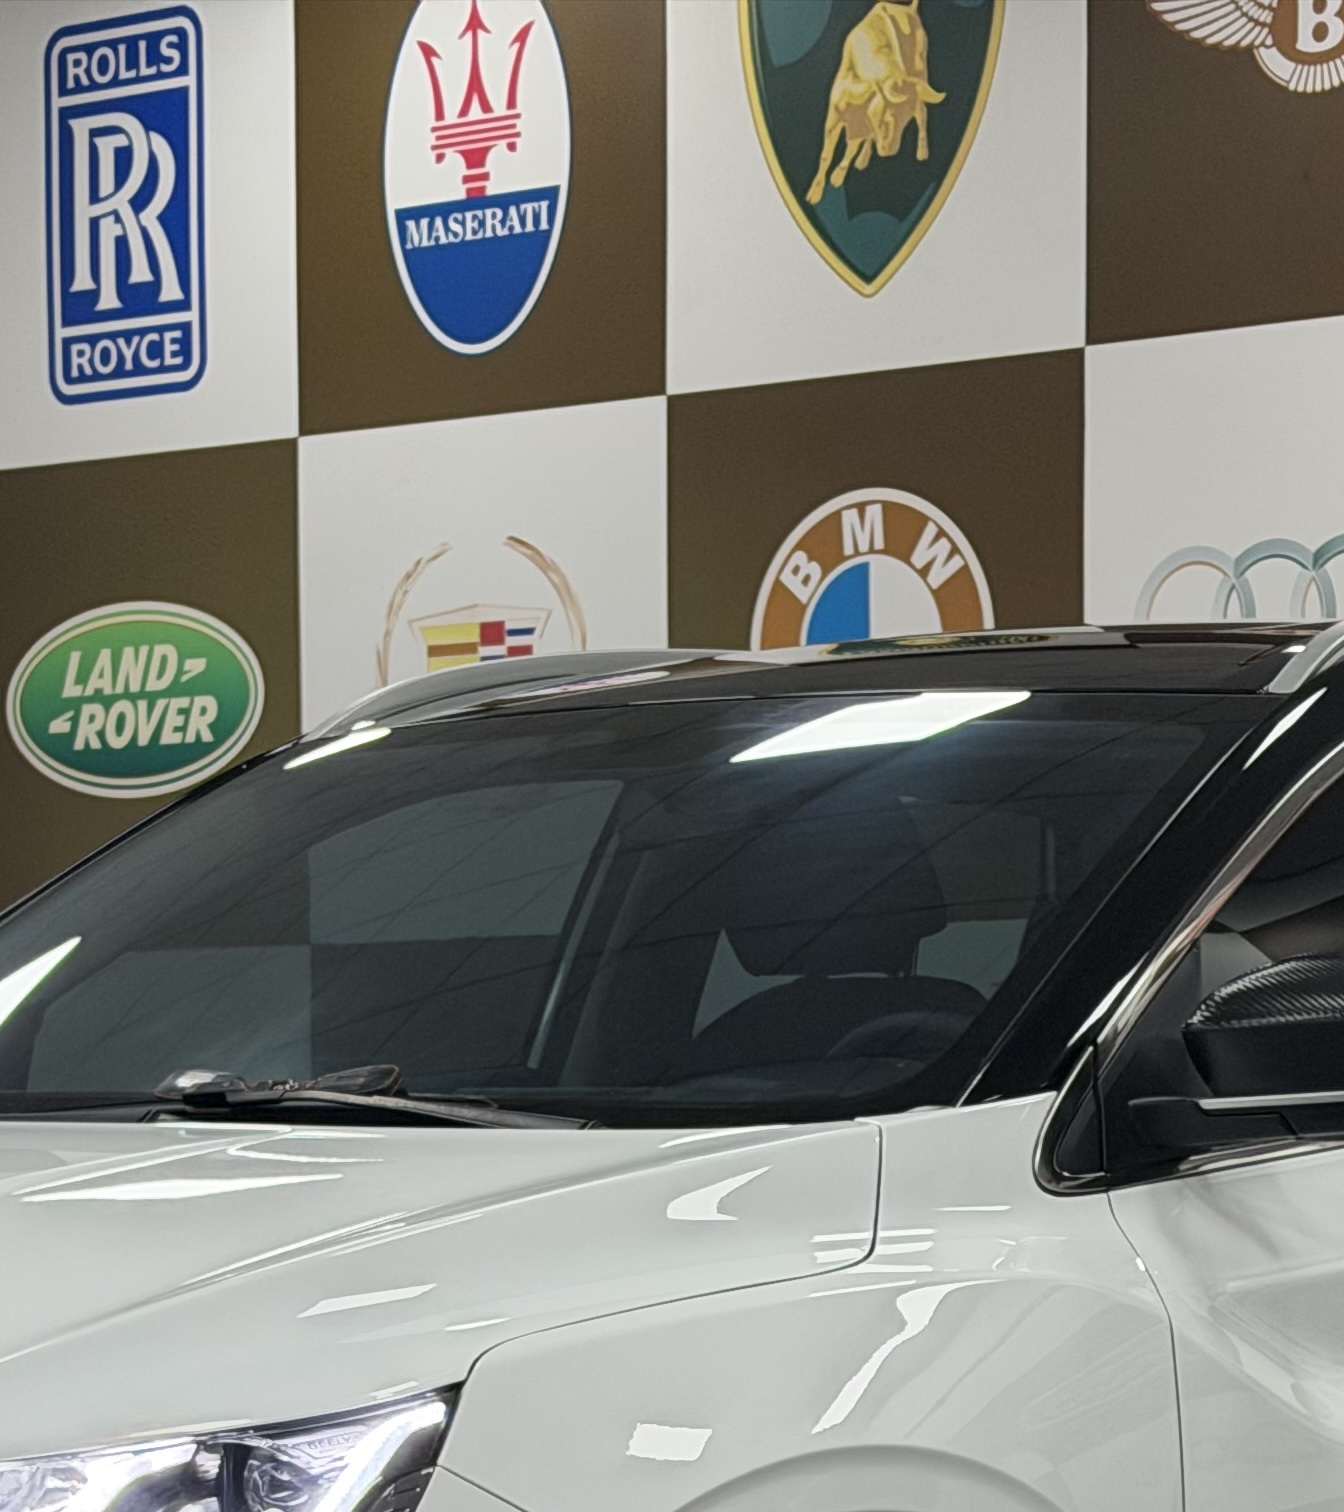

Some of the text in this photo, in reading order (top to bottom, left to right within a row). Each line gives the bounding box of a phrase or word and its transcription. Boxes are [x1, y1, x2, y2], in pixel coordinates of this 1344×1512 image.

[66, 34, 182, 90] ROLLS
[404, 200, 550, 250] MASERATI
[70, 330, 184, 378] ROYCE
[778, 503, 966, 606] BMW
[61, 643, 179, 698] LAND
[73, 695, 219, 751] ROVER
